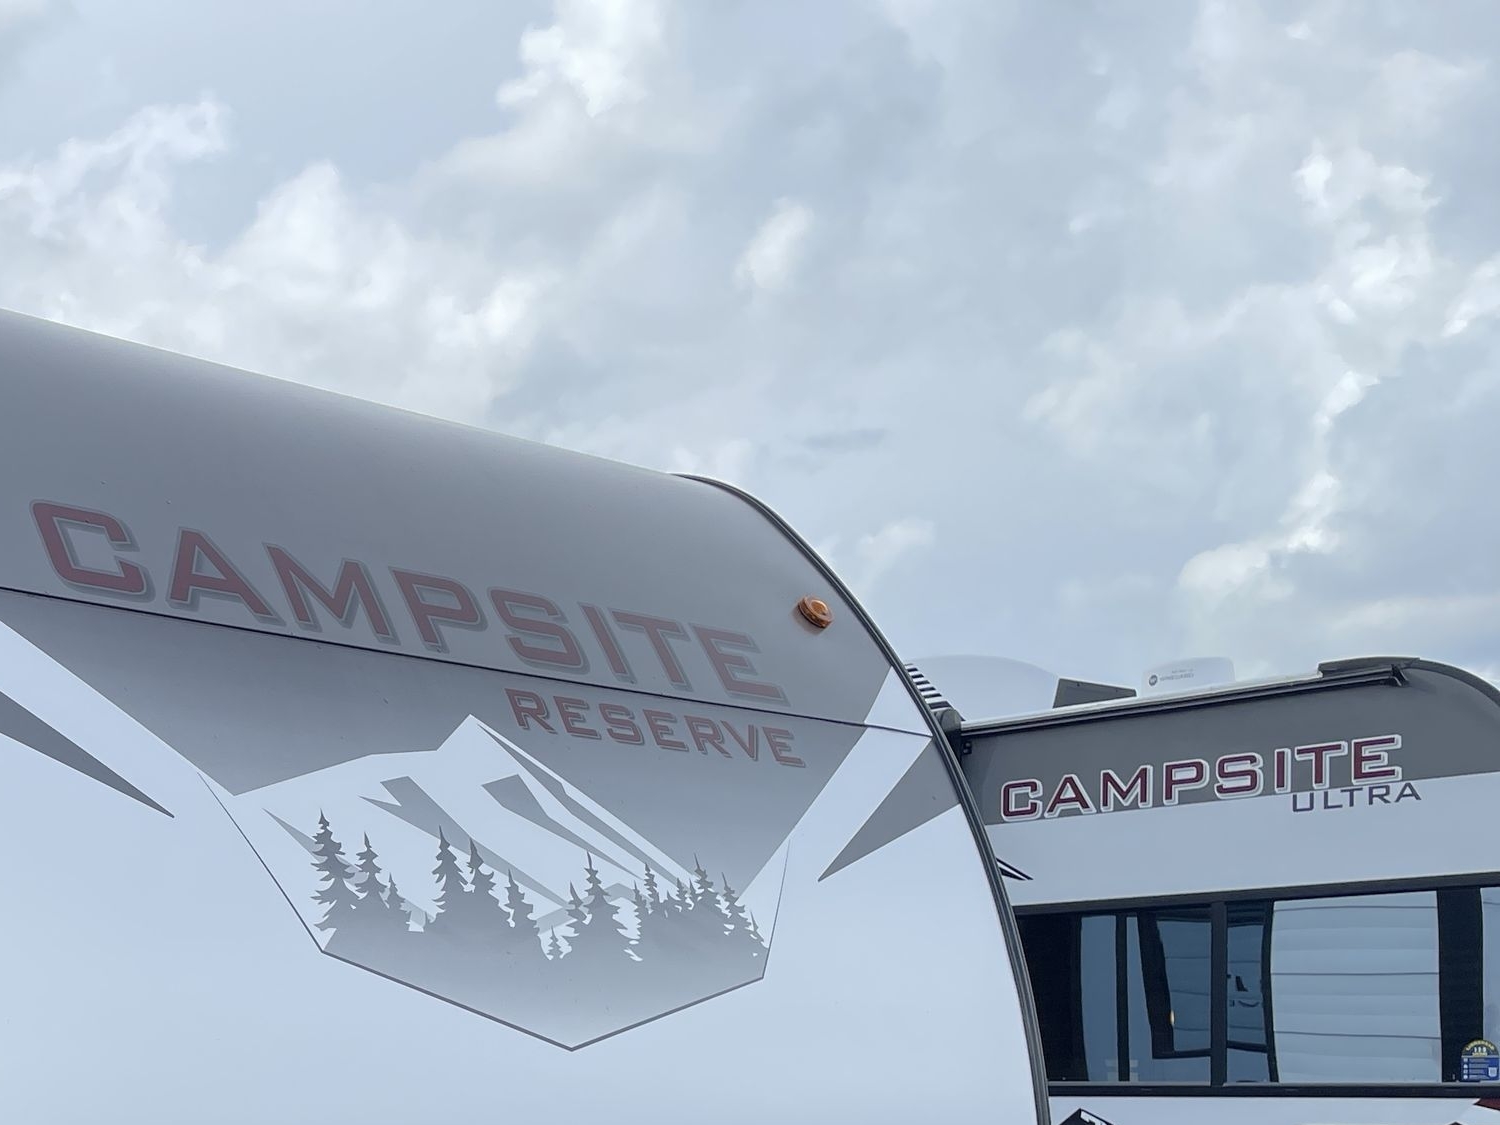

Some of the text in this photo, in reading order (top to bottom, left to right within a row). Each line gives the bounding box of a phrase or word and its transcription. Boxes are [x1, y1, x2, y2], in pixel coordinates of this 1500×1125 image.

[29, 499, 789, 707] CAMPSITE
[503, 687, 807, 768] RESERVE
[1000, 733, 1403, 824] CAMPSITE
[1291, 781, 1423, 814] ULTRA
